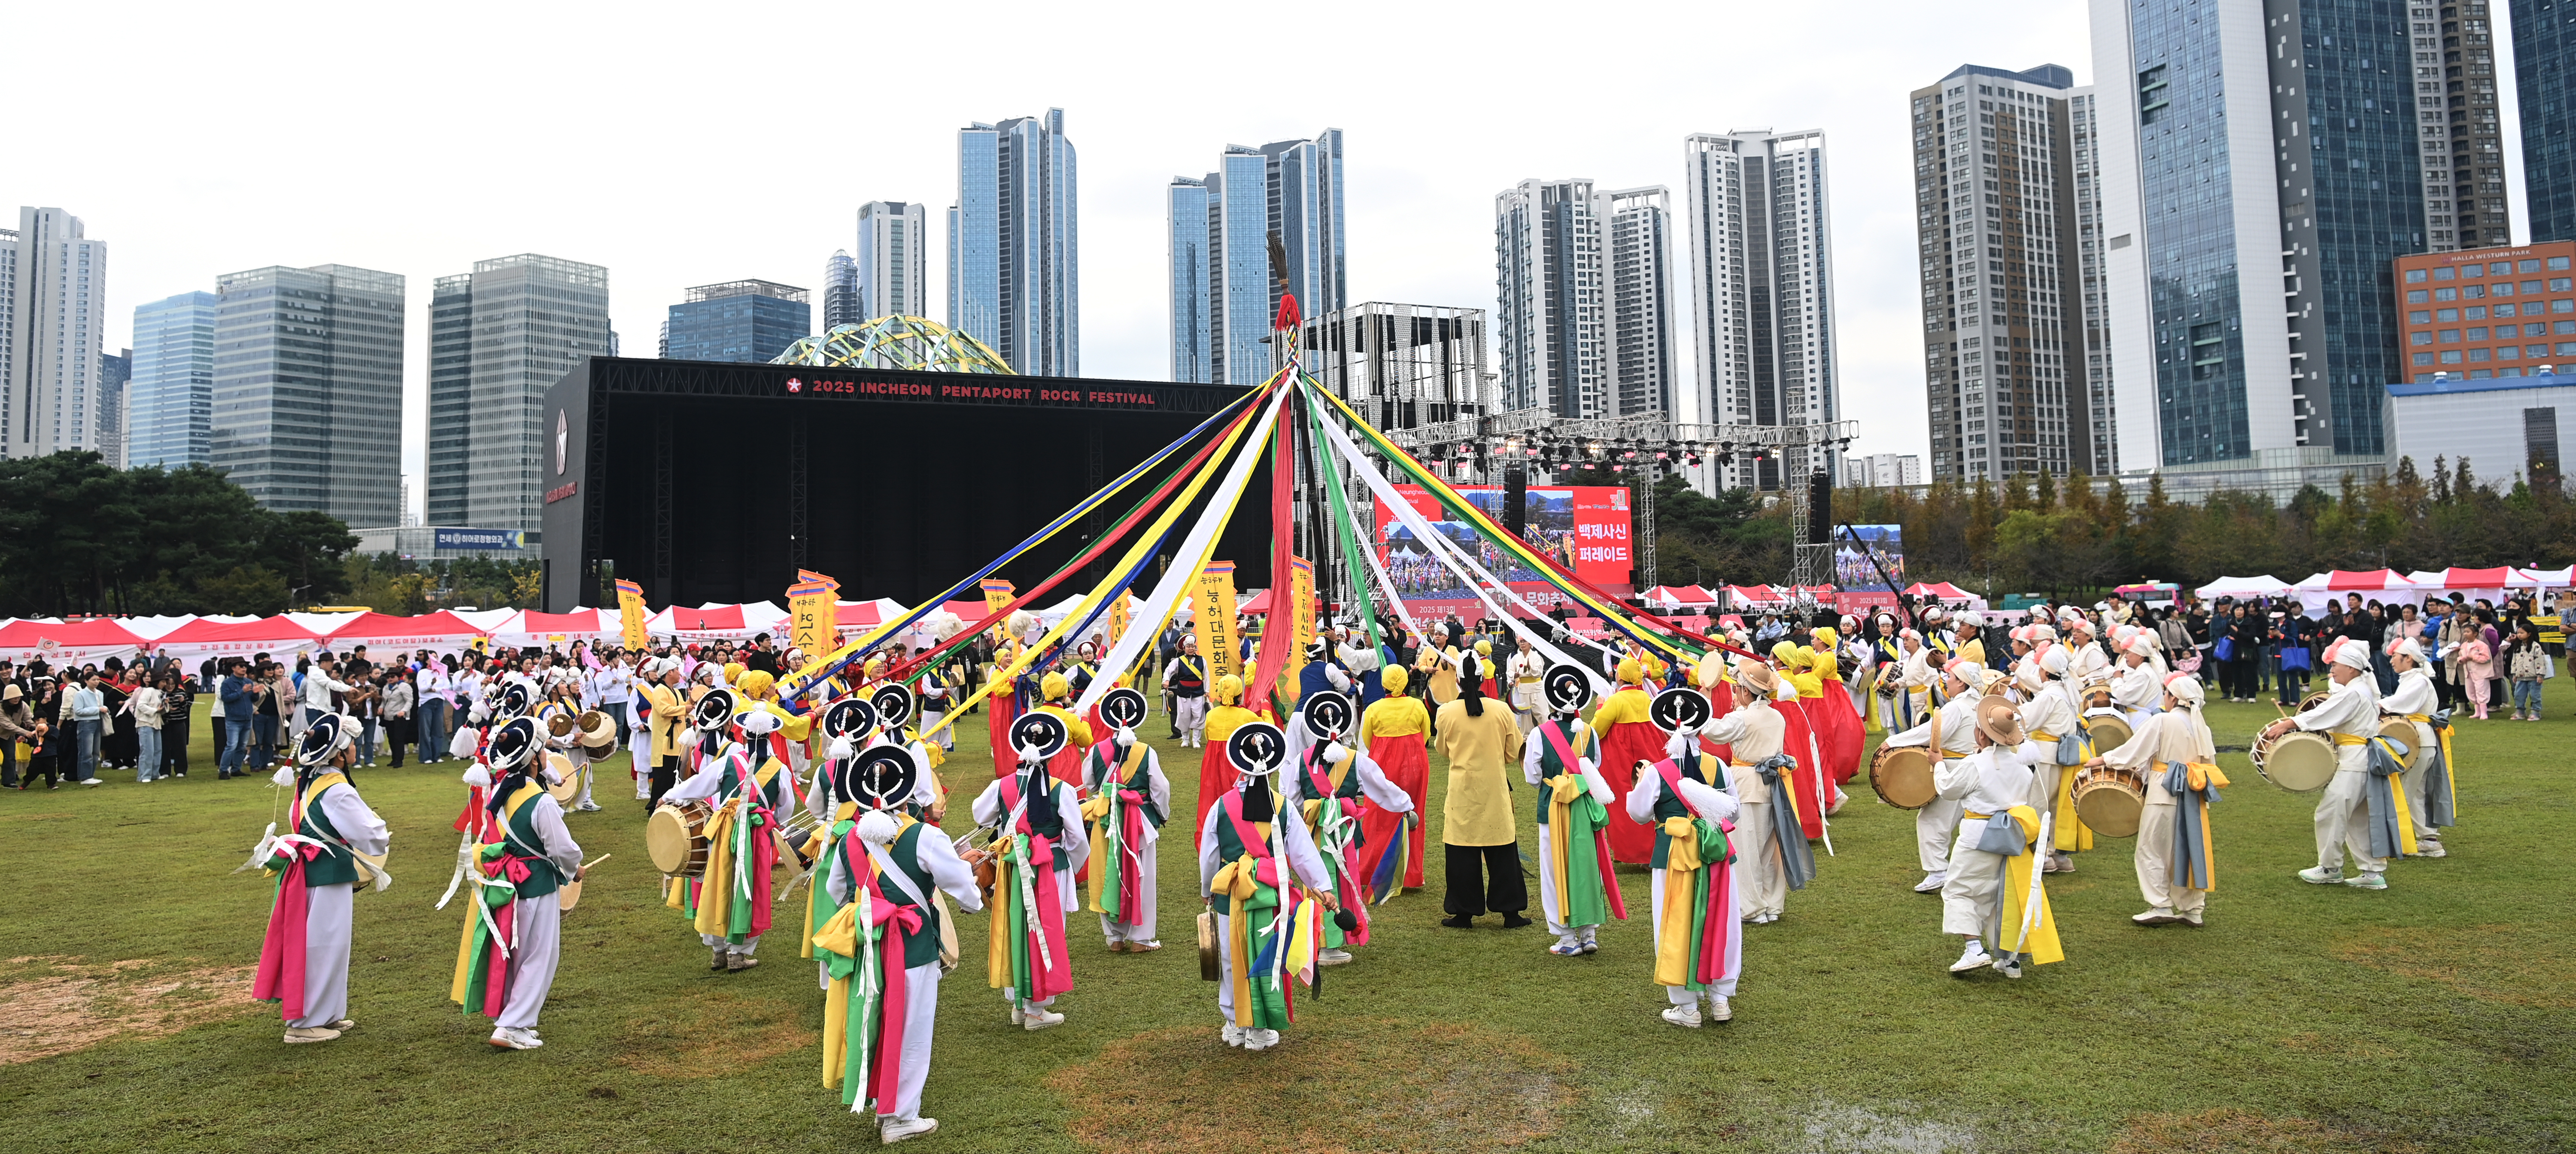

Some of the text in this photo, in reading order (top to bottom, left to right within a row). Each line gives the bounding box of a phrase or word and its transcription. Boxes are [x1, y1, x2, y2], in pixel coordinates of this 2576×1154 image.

[2476, 251, 2509, 260] WESTURN
[813, 380, 1155, 404] 2025 INCHEON PENTAPORT ROCK FESTIVAL
[439, 534, 503, 544] 연세 히어로정형외과
[1578, 523, 1626, 540] 백제사신
[1579, 546, 1628, 562] 퍼레이드
[1526, 592, 1574, 609] 문화축제
[1437, 605, 1455, 613] 제13회
